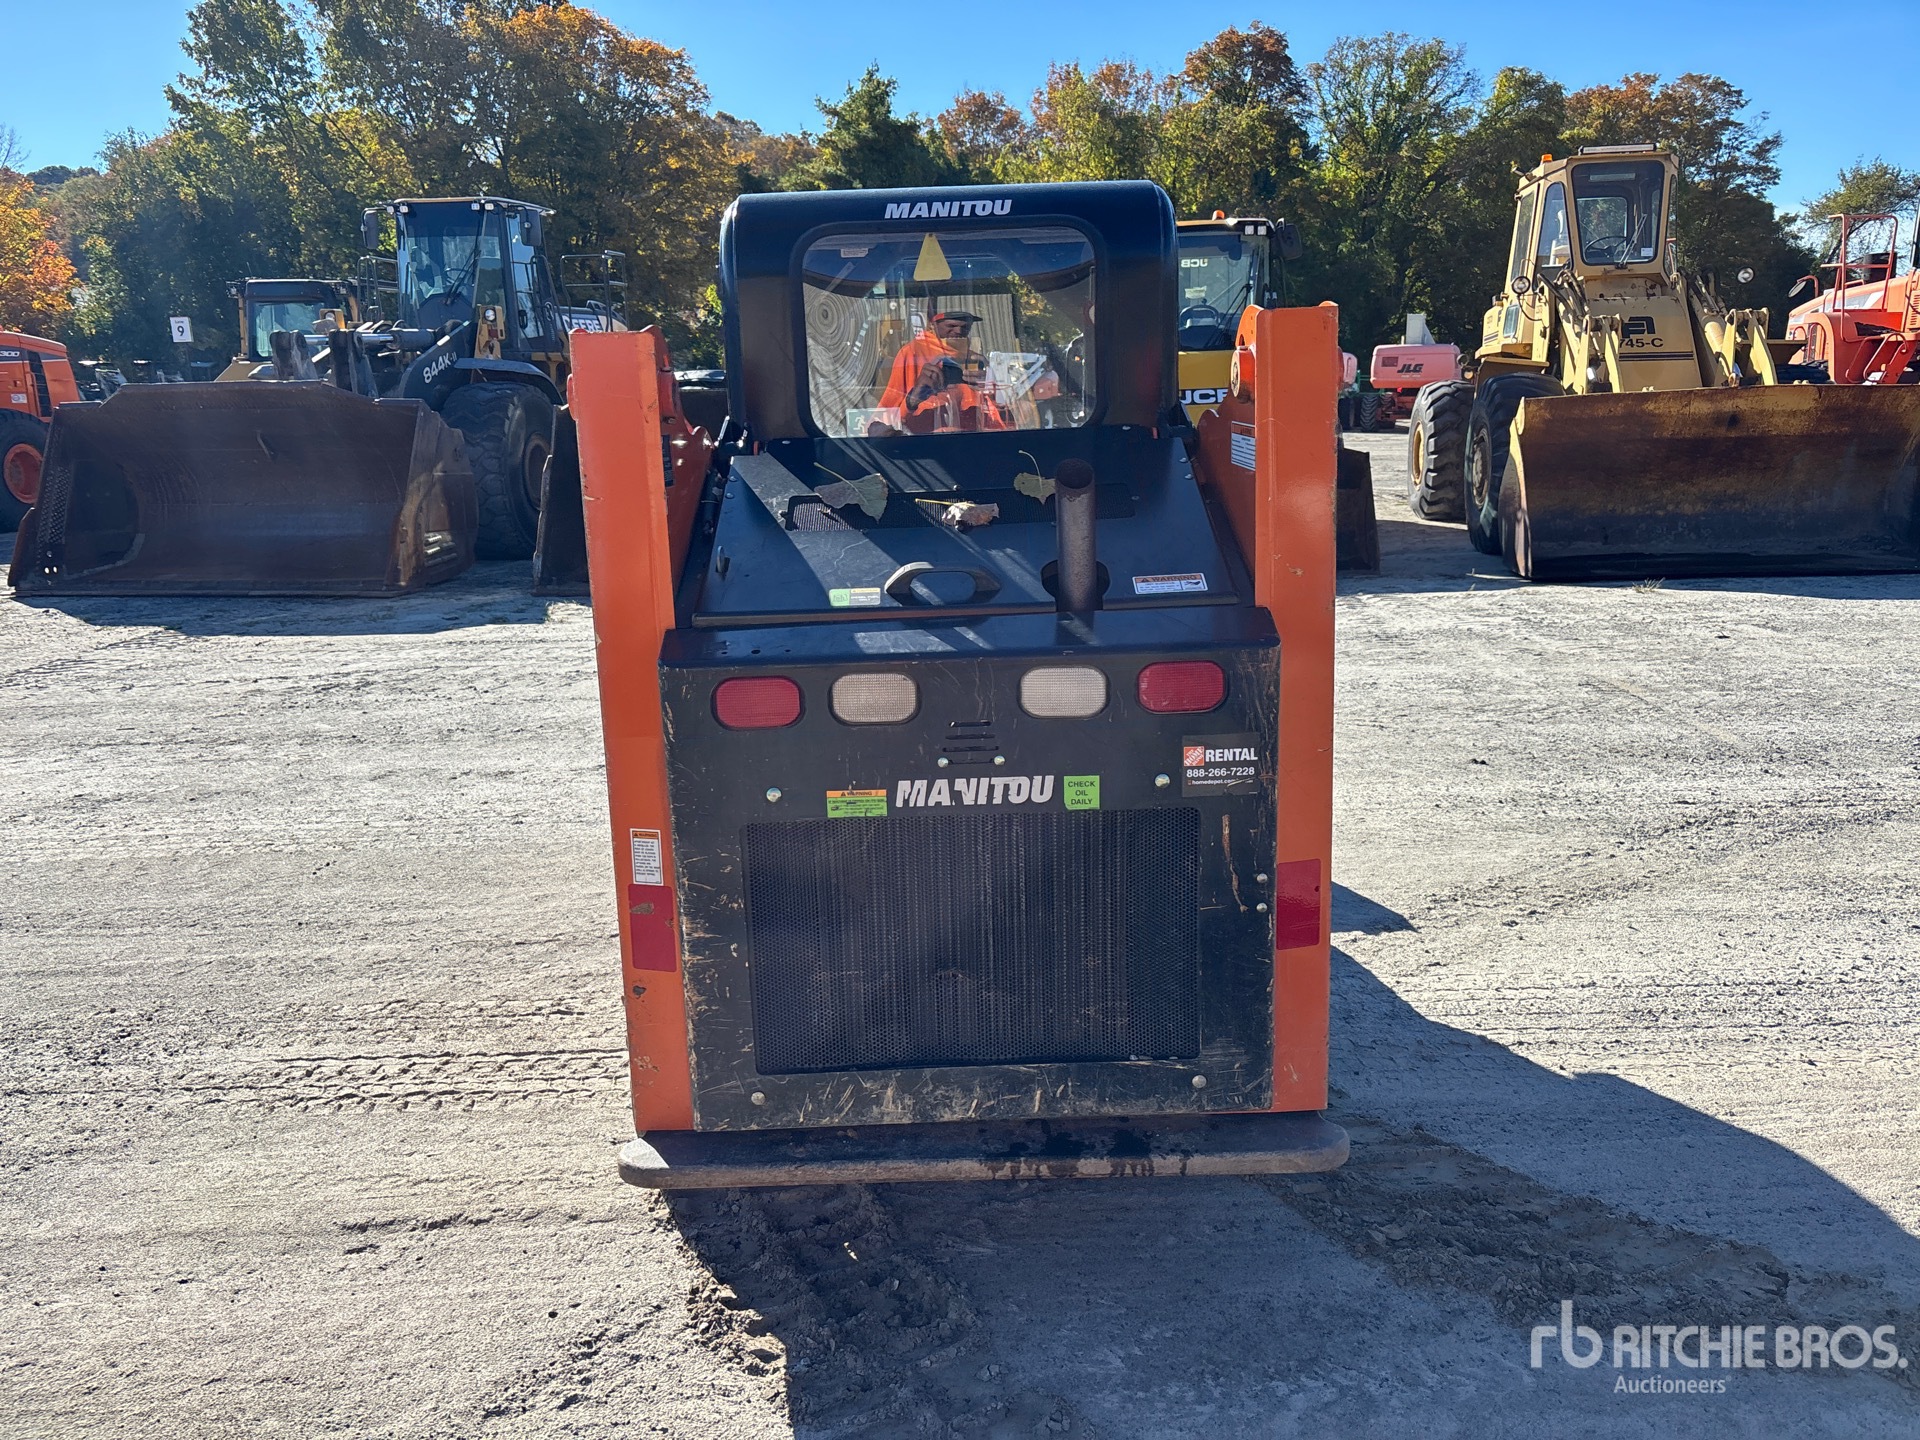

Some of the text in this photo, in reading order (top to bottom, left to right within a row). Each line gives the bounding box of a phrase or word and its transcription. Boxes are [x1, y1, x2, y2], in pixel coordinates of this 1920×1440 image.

[884, 199, 1012, 219] MANITOU
[177, 325, 185, 337] 9
[1396, 363, 1424, 373] JLG
[1152, 574, 1197, 582] WARNING
[1205, 747, 1258, 762] RENTAL
[1186, 767, 1255, 778] 888-266-7228
[1067, 780, 1096, 788] CHECK
[895, 775, 1054, 808] MANITOU
[1070, 798, 1093, 806] DAILY
